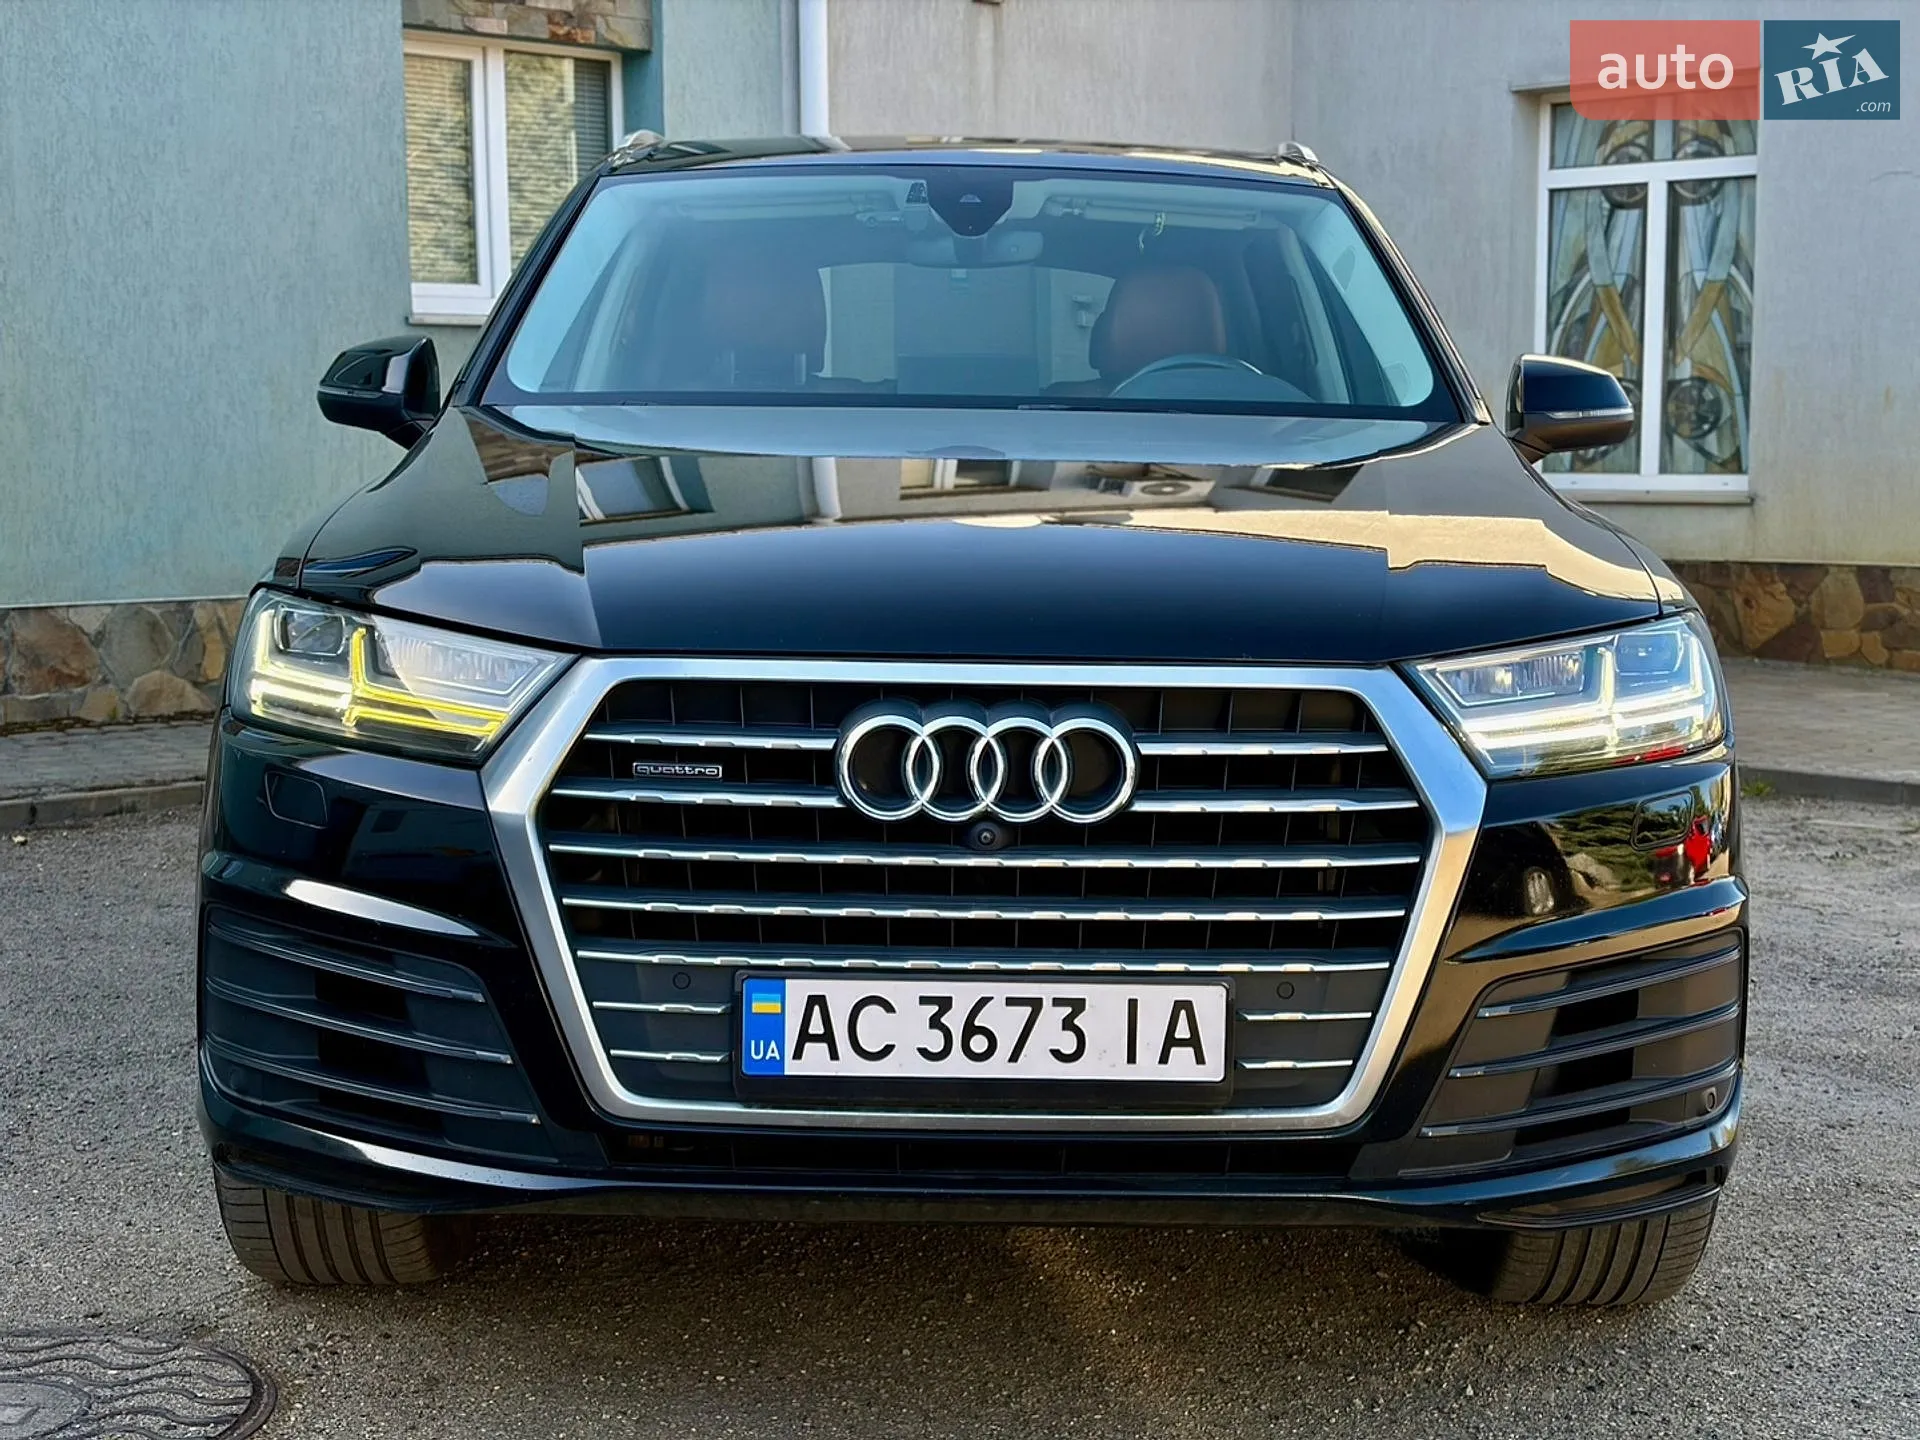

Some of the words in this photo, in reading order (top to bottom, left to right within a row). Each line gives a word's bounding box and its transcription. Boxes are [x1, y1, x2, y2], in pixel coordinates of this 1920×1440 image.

[636, 765, 718, 775] quattro
[792, 994, 897, 1062] AC
[915, 995, 1087, 1064] 3673
[1126, 997, 1206, 1065] IA
[751, 1040, 781, 1061] UA
